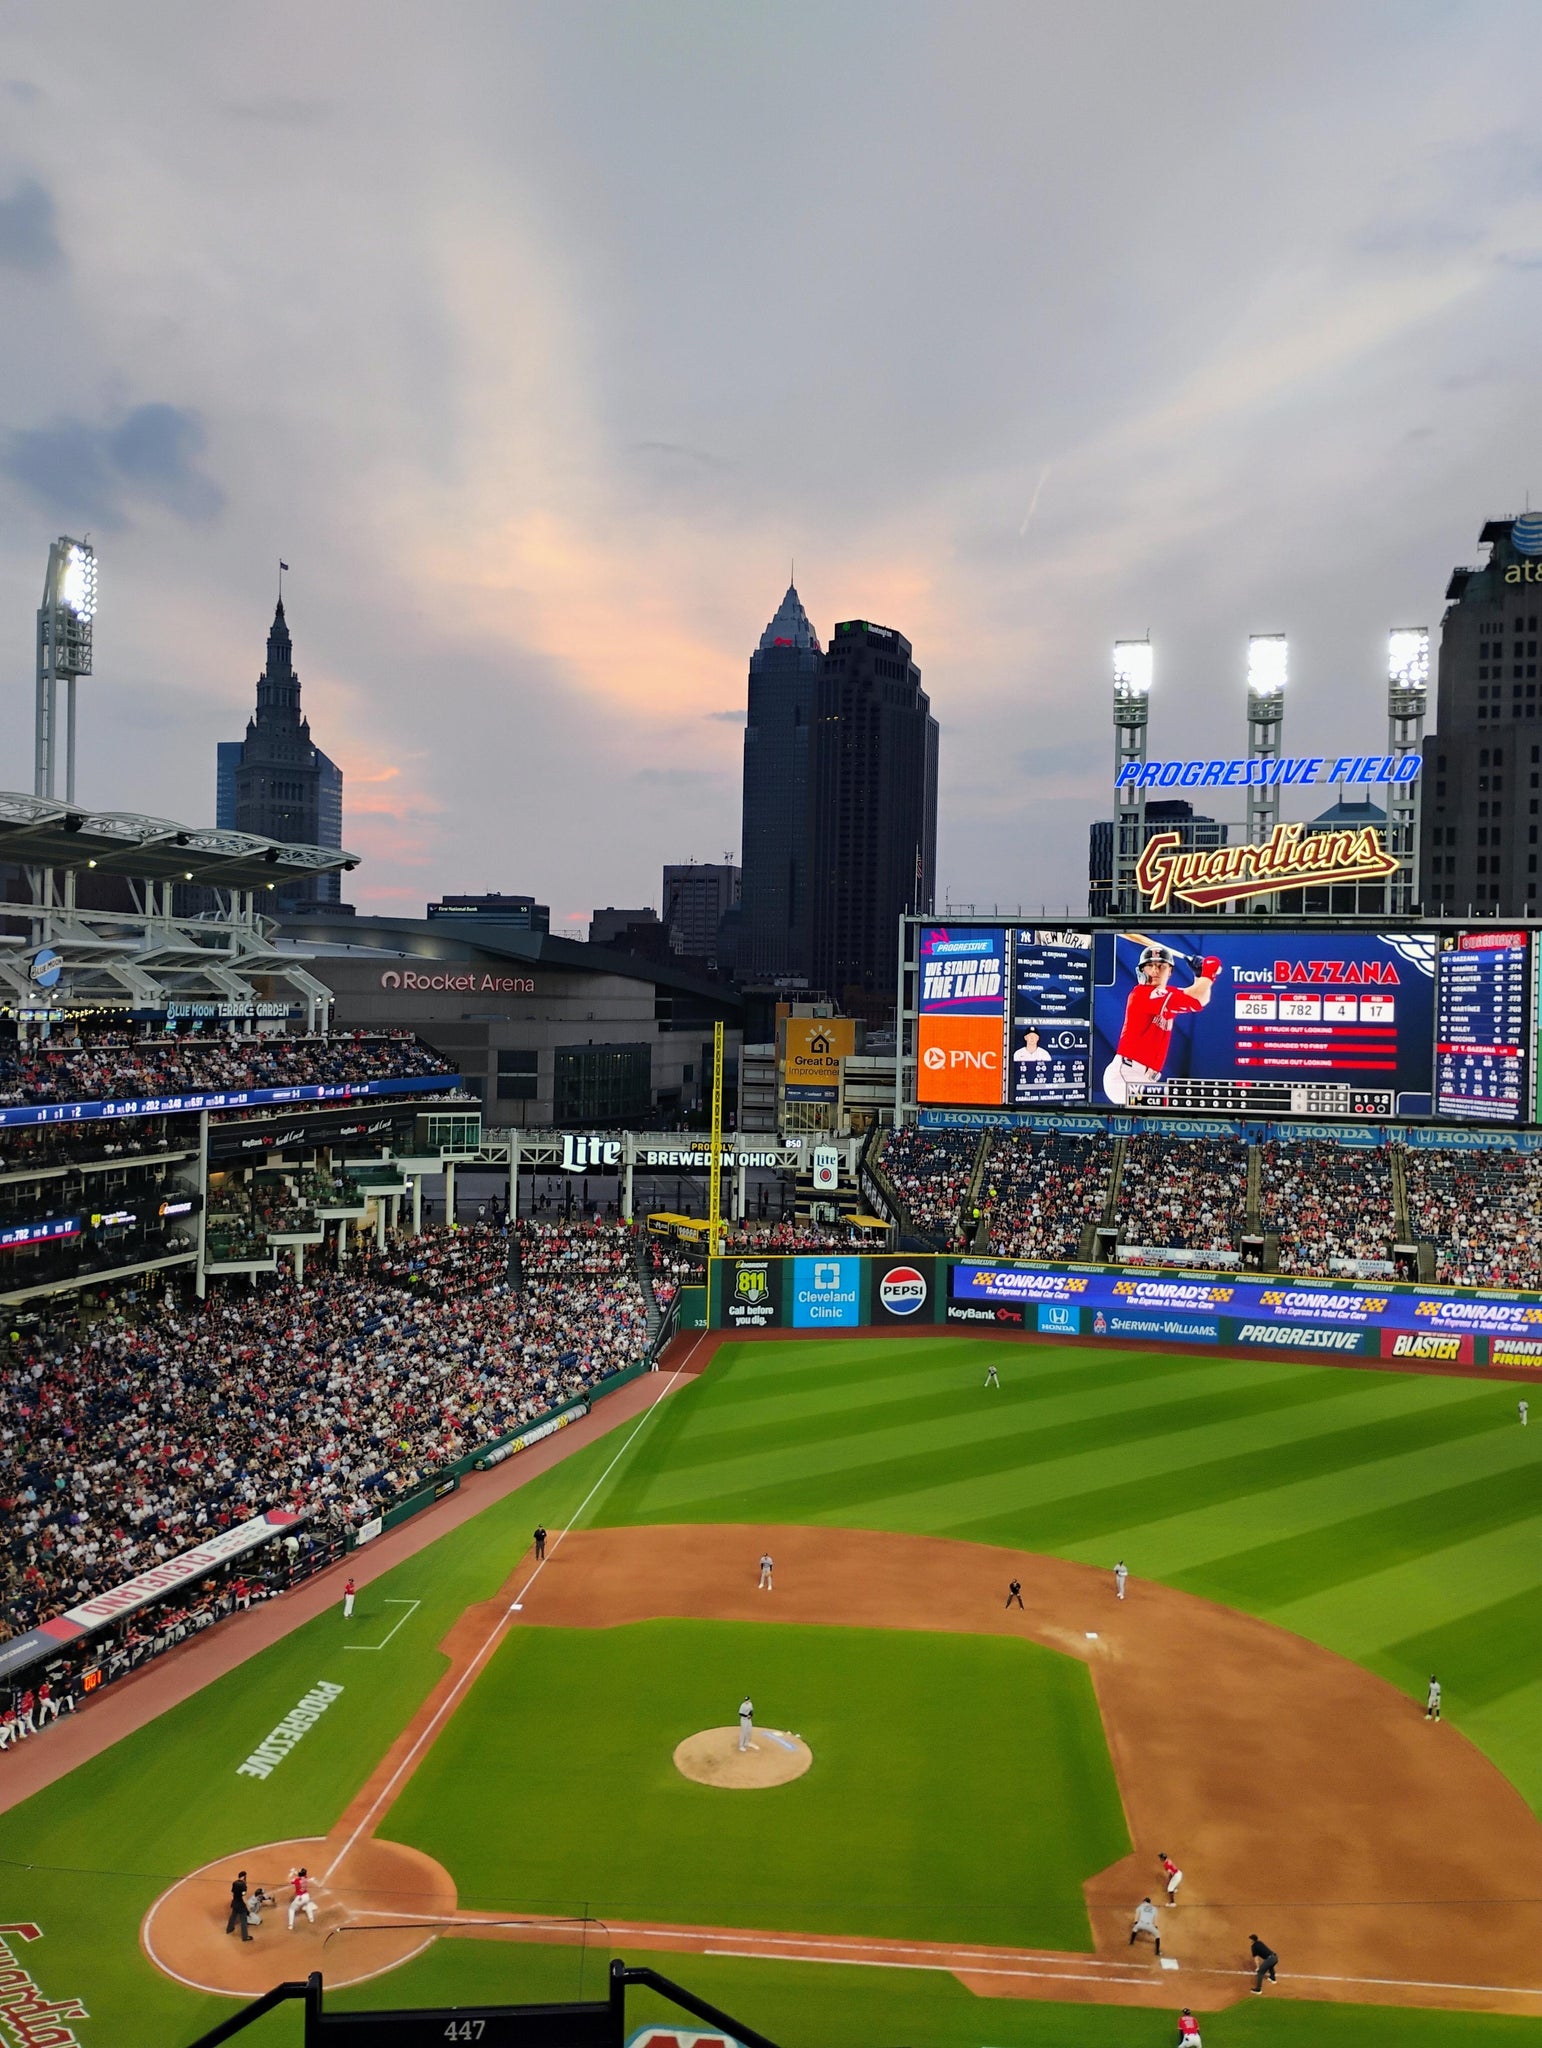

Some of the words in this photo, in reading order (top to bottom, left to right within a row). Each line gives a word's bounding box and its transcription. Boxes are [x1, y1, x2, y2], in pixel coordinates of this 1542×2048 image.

[1114, 758, 1326, 788] PROGRESSIVE
[1328, 755, 1422, 785] FIELD
[1136, 822, 1400, 910] Guardians
[937, 942, 988, 953] PROGRESSIVE
[925, 961, 943, 977] WE
[943, 960, 978, 975] STAND
[978, 958, 1000, 974] FOR
[1231, 965, 1273, 983] Travis
[1273, 960, 1401, 985] BAZZANA
[403, 970, 476, 991] Rocket
[480, 973, 535, 993] Arena
[923, 976, 954, 999] THE
[954, 973, 1001, 998] LAND
[167, 1001, 190, 1019] BLUE
[191, 1003, 214, 1016] MOON
[217, 1003, 255, 1017] TERRACE
[255, 1003, 289, 1017] GARDEN
[1241, 1003, 1268, 1015] .265
[1286, 1004, 1312, 1016] .782
[1337, 1005, 1346, 1016] 4
[1370, 1006, 1383, 1017] 17
[794, 1056, 823, 1067] Great
[948, 1050, 998, 1070] PNC
[1363, 1094, 1368, 1103] 1
[1381, 1094, 1389, 1104] 2
[944, 1113, 1012, 1125] HONDA
[1033, 1117, 1105, 1129] HONDA
[1160, 1121, 1235, 1134] HONDA
[1296, 1125, 1374, 1139] HONDA
[785, 1139, 802, 1148] 8:50
[1436, 1131, 1518, 1145] HONDA
[559, 1134, 622, 1173] Lite
[691, 1142, 735, 1151] PROLY
[738, 1153, 777, 1167] OHIO
[816, 1153, 836, 1168] Lite
[961, 1258, 998, 1266] PROGRESSIVE
[1013, 1261, 1053, 1270] PROGRESSIVE
[1067, 1264, 1106, 1273] PROGRESSIVE
[1122, 1268, 1162, 1277] PROGRESSIVE
[1178, 1271, 1219, 1281] PROGRESSIVE
[1235, 1275, 1277, 1284] PROGRESSIVE
[738, 1271, 765, 1291] 811
[995, 1273, 1066, 1290] CONRAD'S
[1293, 1280, 1336, 1288] PROGRESSIVE
[1352, 1283, 1395, 1292] PROGRESSIVE
[798, 1290, 856, 1304] Cleveland
[883, 1286, 923, 1296] PEPSI
[1136, 1283, 1209, 1300] CONRAD'S
[1413, 1287, 1456, 1296] PROGRESSIVE
[1475, 1290, 1520, 1300] PROGRESSIVE
[1284, 1292, 1363, 1311] CONRAD'S
[729, 1305, 745, 1315] Call
[747, 1305, 774, 1315] before
[810, 1306, 843, 1318] Clinic
[947, 1306, 996, 1321] KeyBank
[1441, 1303, 1523, 1321] CONRAD'S
[693, 1319, 707, 1327] 325
[735, 1317, 751, 1327] you
[751, 1315, 767, 1327] dig.
[1040, 1324, 1076, 1333] HONDA
[1238, 1324, 1361, 1350] PROGRESSIVE
[1392, 1335, 1461, 1361] BLASTER
[81, 1552, 217, 1617] CLEVELAND
[235, 1680, 345, 1780] PROGRESSIVE
[443, 2020, 486, 2041] 447
